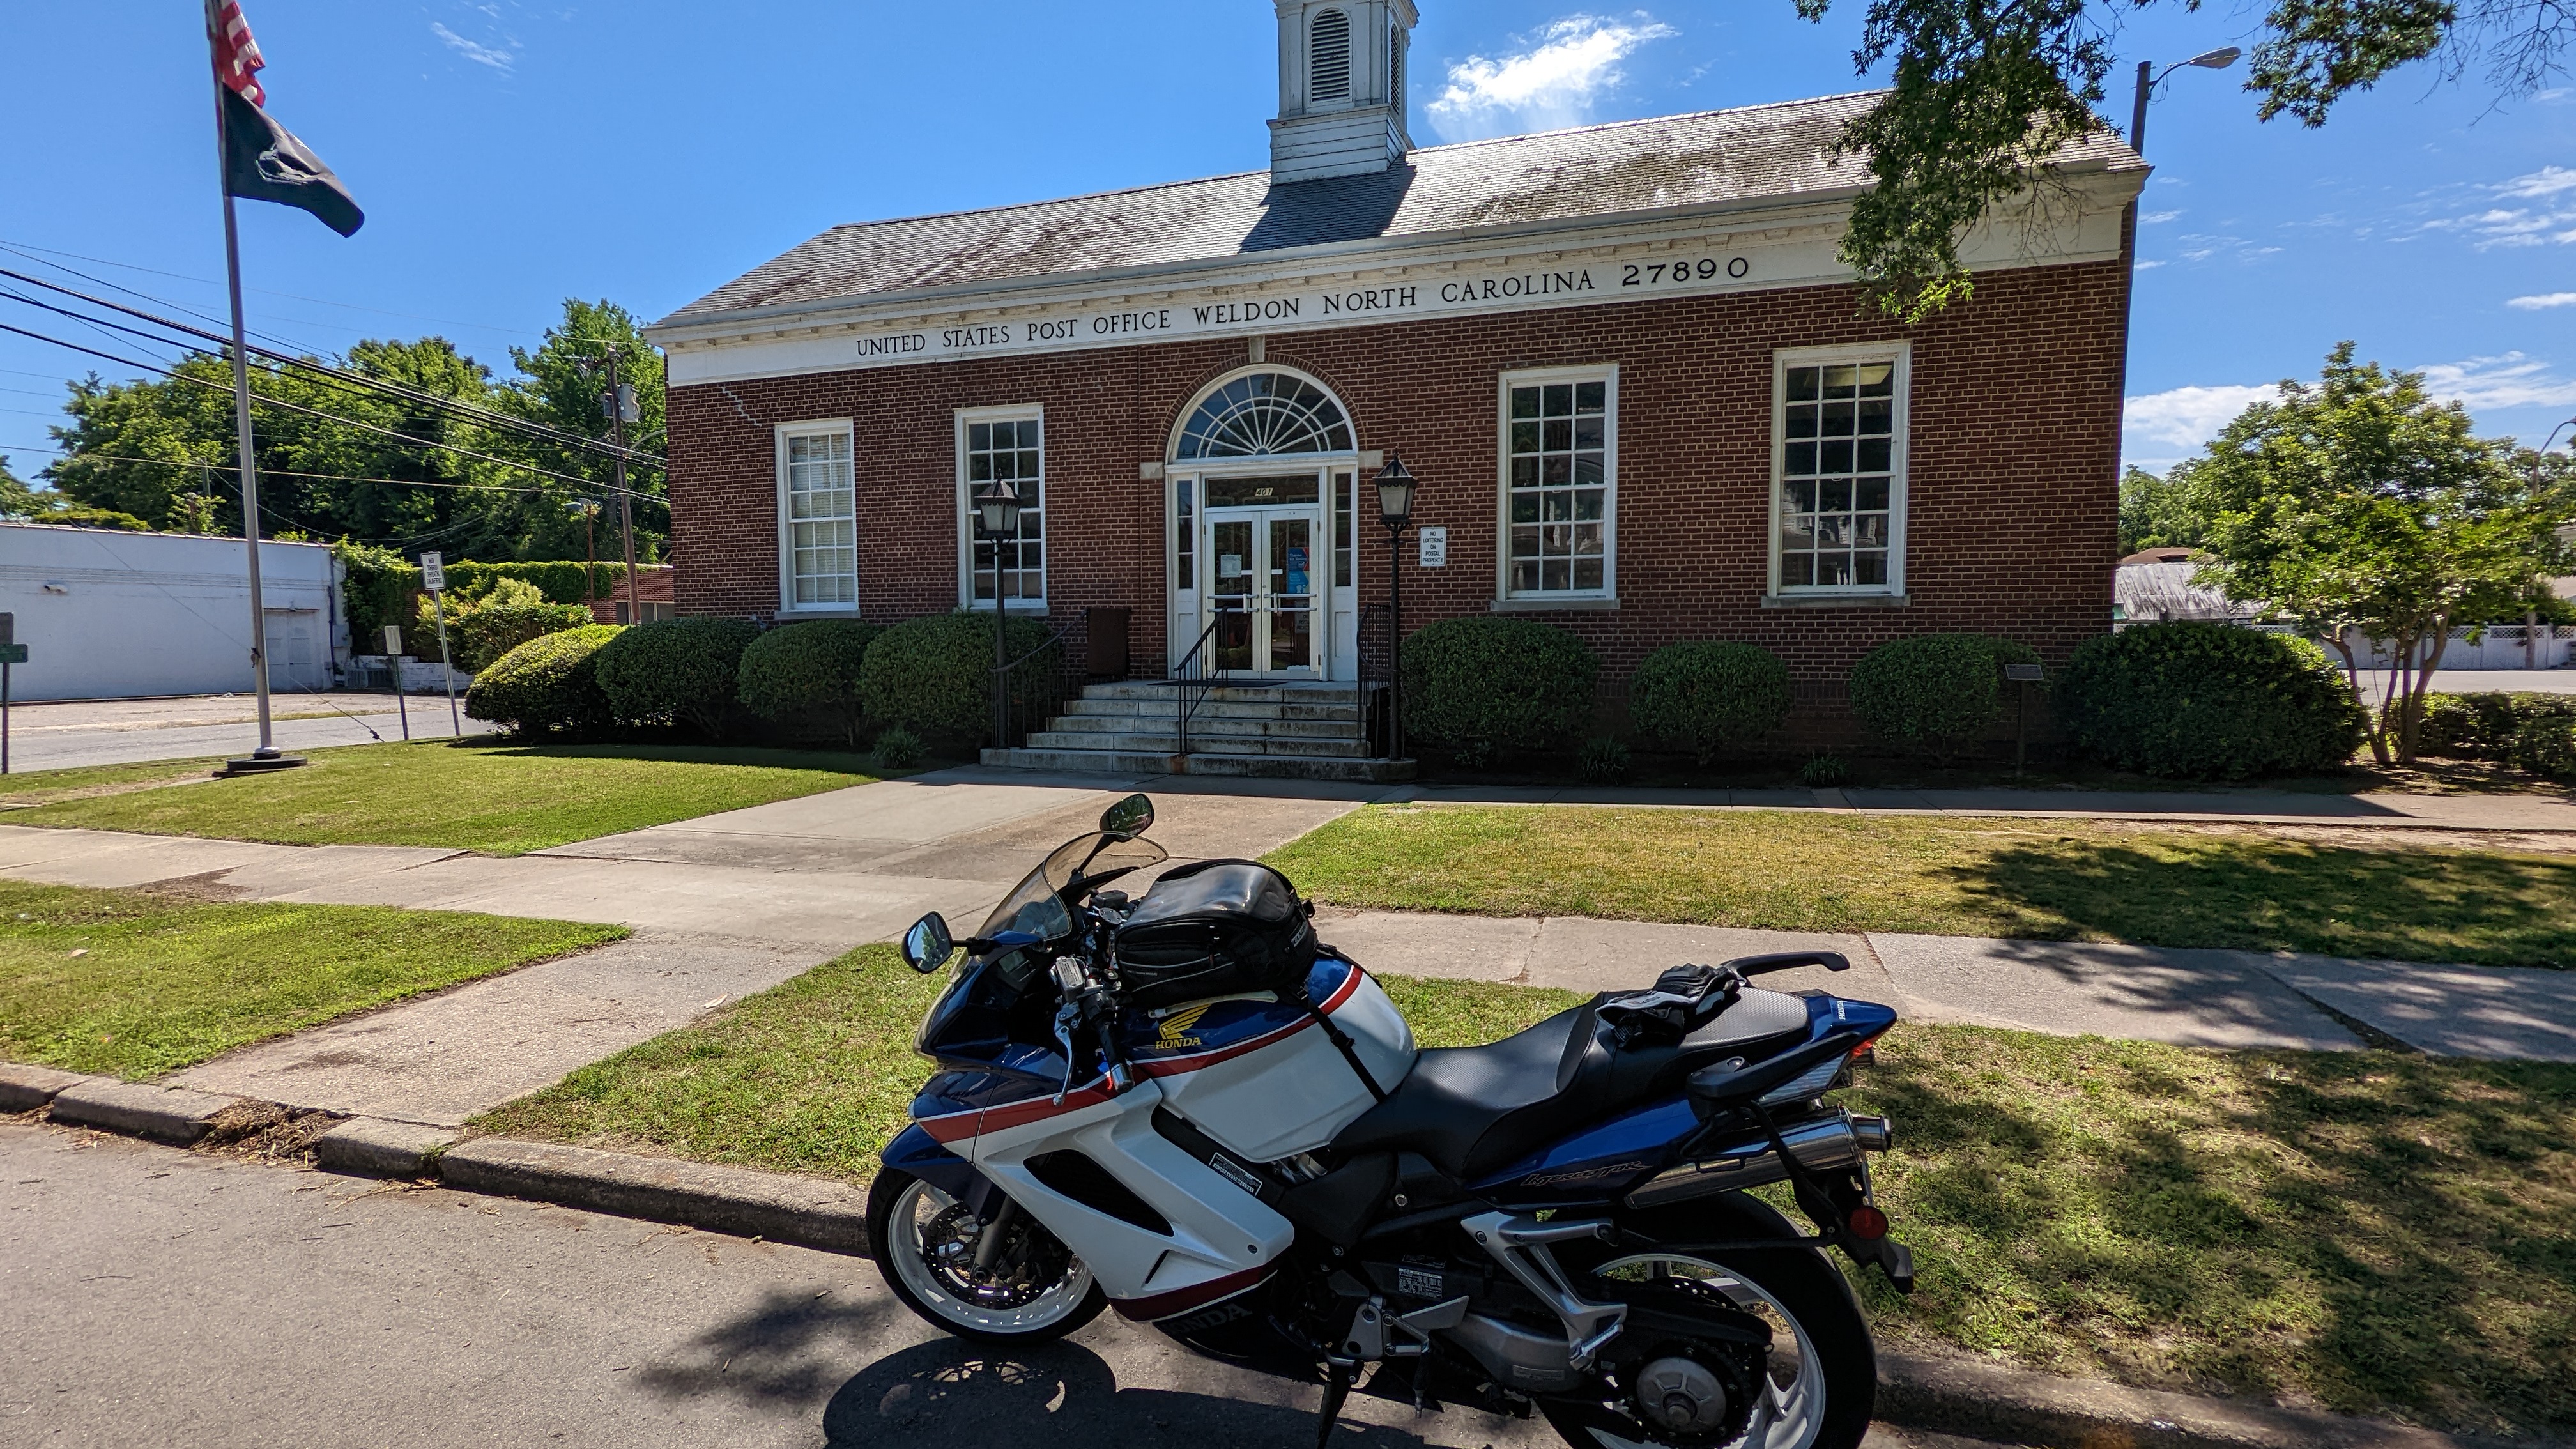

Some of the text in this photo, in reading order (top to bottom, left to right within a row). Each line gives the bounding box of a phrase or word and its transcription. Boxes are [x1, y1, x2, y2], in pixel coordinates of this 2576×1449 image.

[857, 257, 1749, 356] UNITED STATES POST OFFICE WELDON NORTH CAROLINA 27890
[1837, 999, 1846, 1020] HONDA
[1155, 1036, 1202, 1050] HONDA
